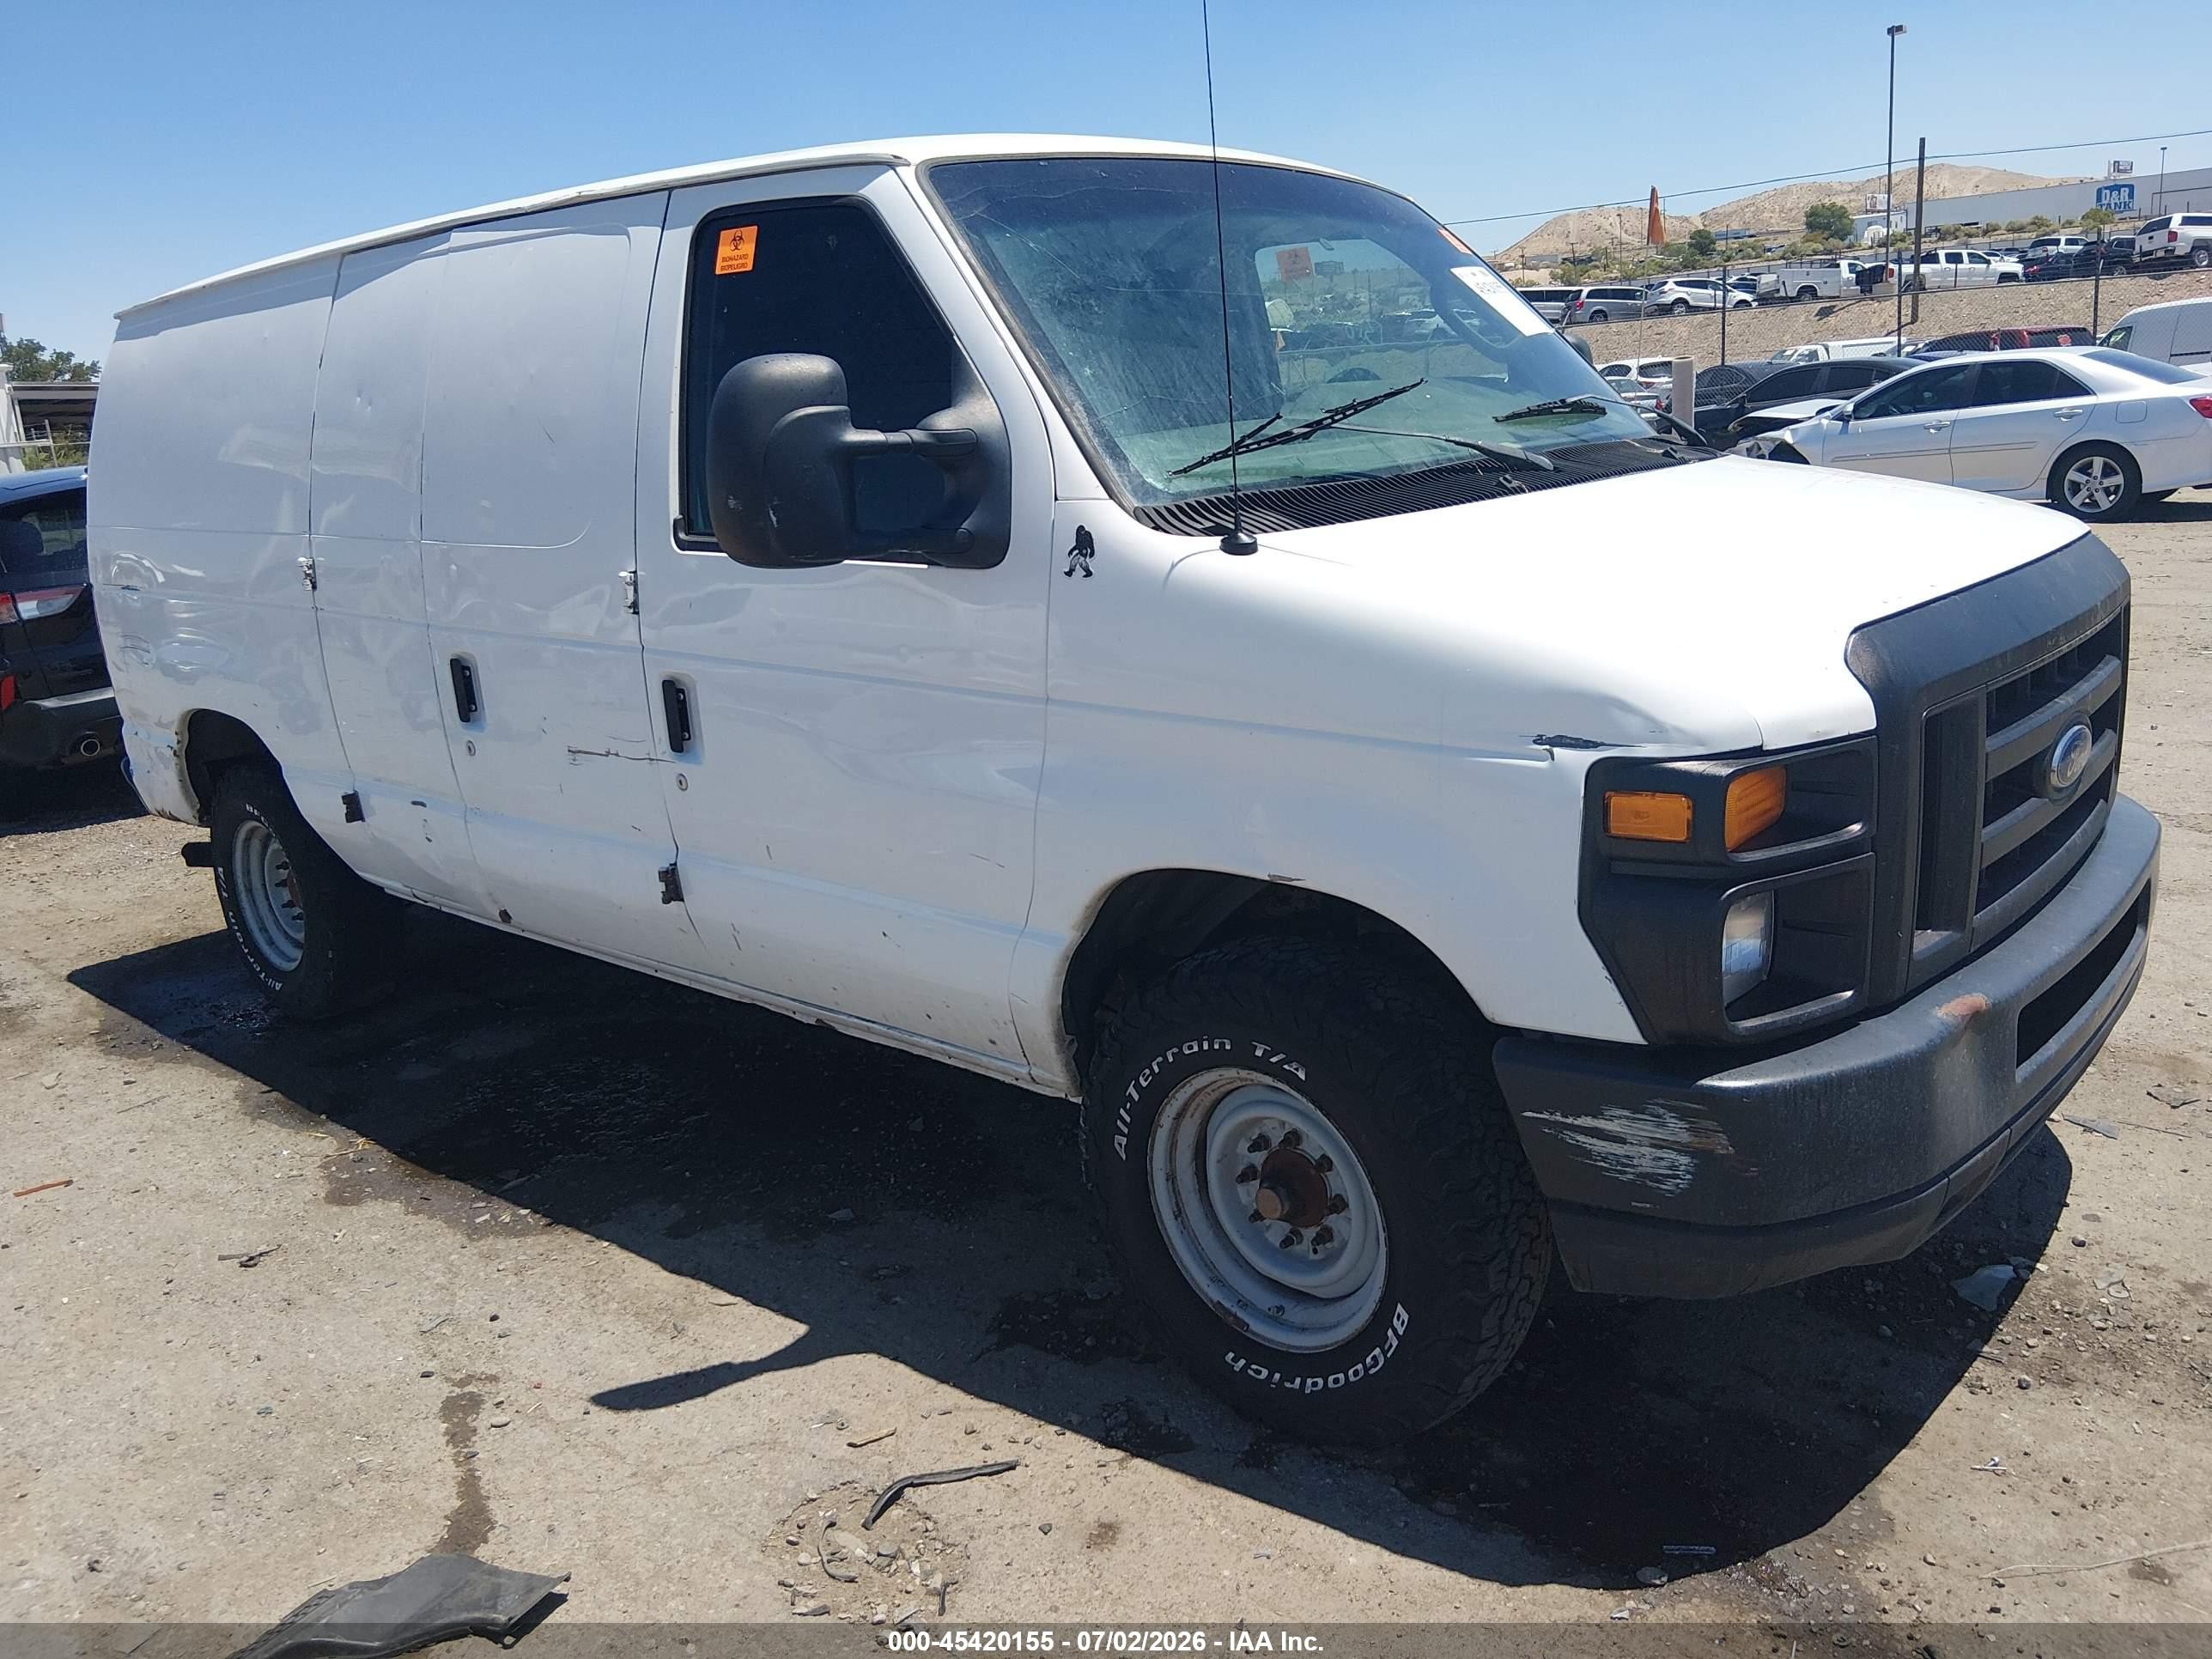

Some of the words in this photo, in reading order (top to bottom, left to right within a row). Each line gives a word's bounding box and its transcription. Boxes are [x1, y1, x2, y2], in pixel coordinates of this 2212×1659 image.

[2096, 199, 2134, 211] TANK
[2102, 187, 2130, 204] D&R
[1113, 1036, 1232, 1162] All-Terrain
[1250, 1040, 1306, 1082] T/A
[1224, 1301, 1410, 1395] BFGoodrich
